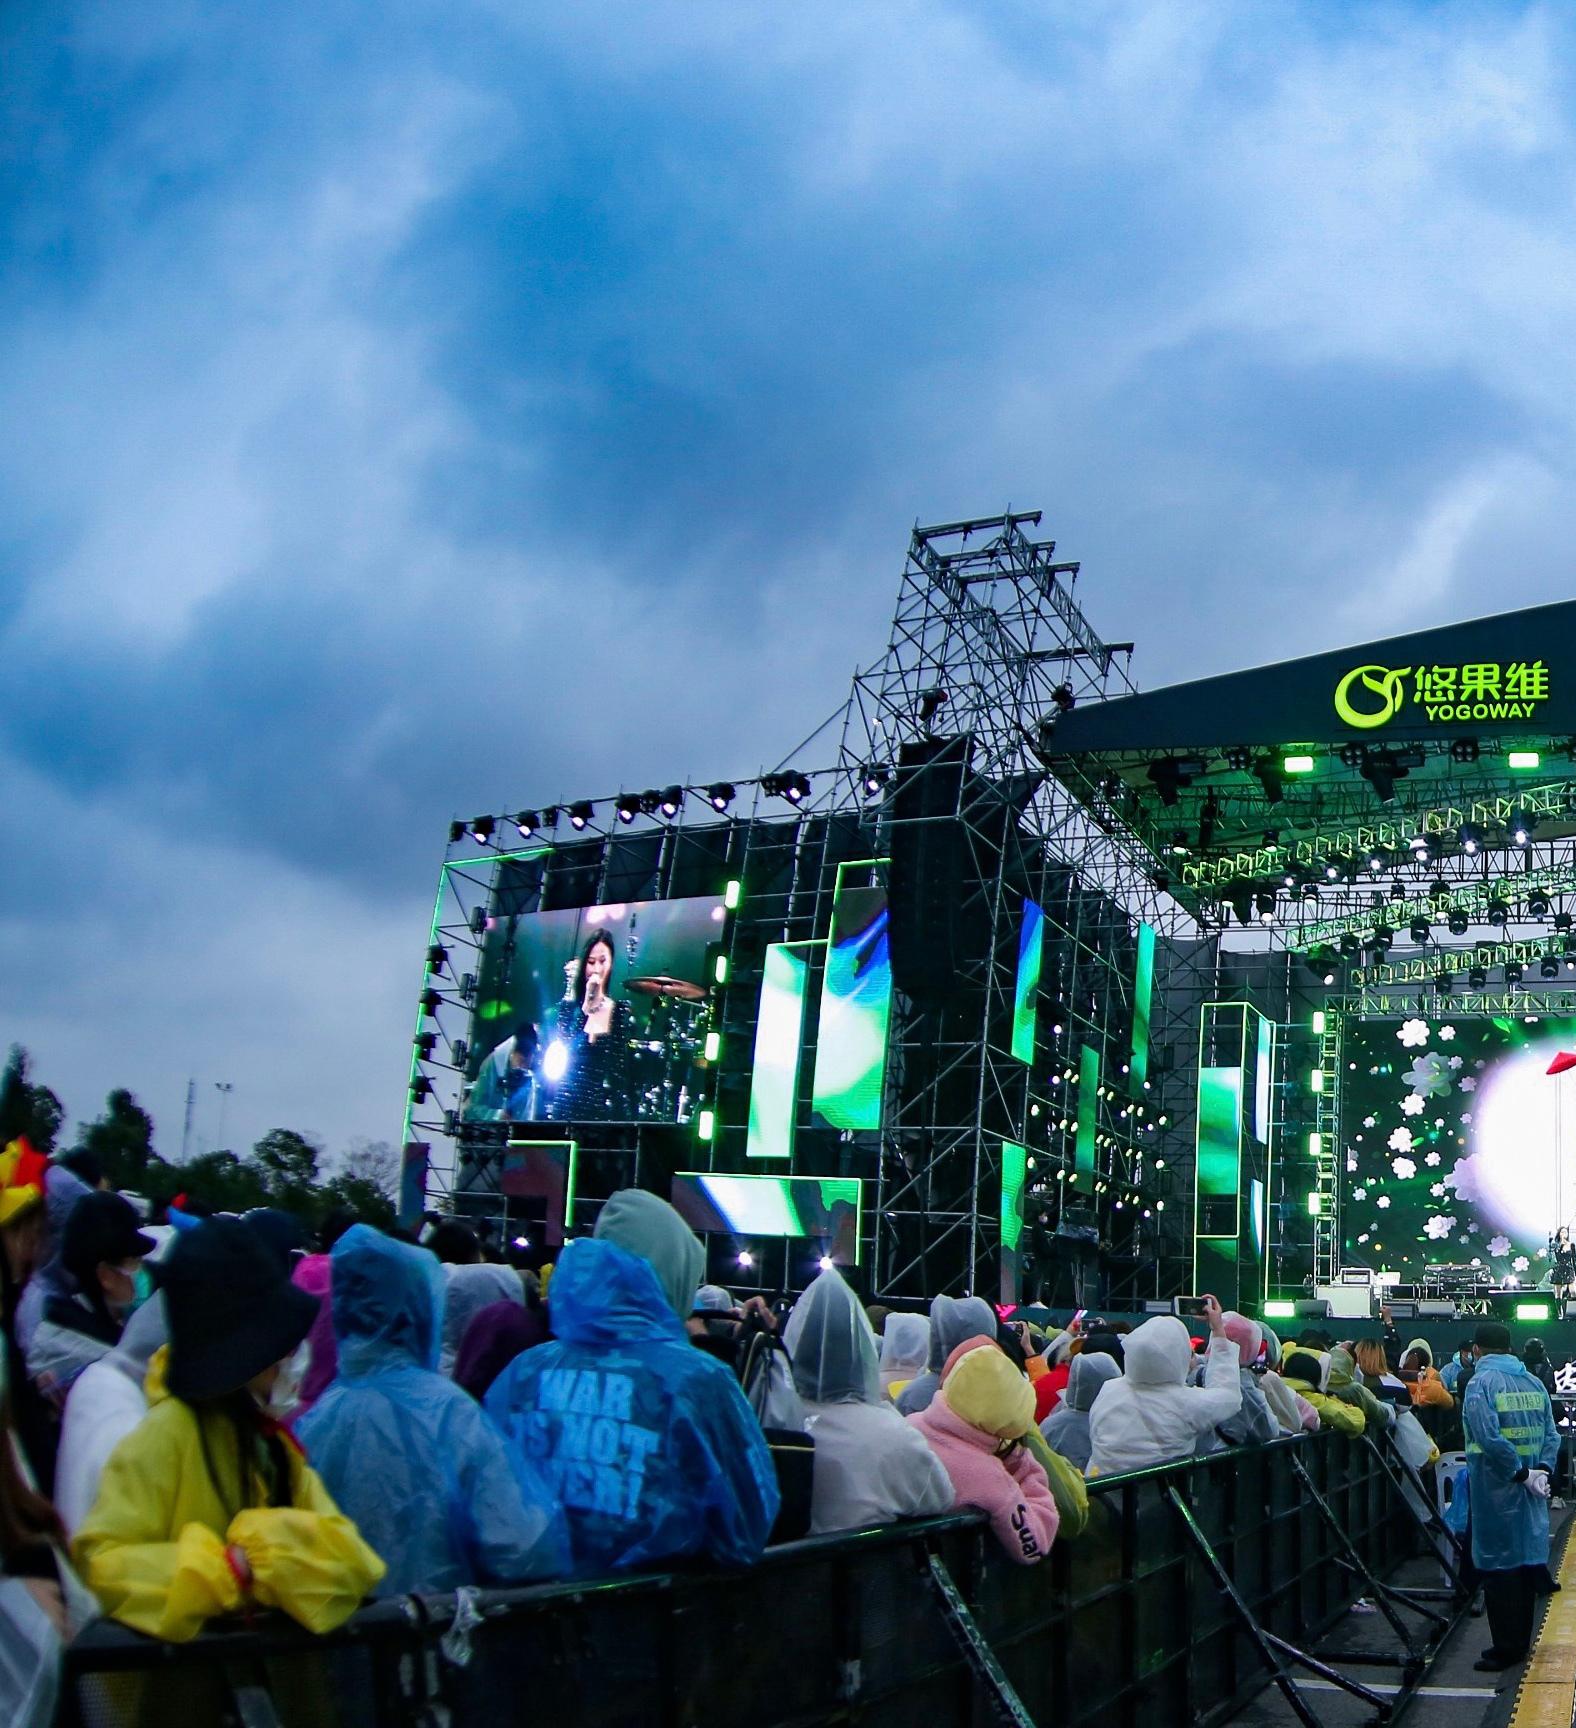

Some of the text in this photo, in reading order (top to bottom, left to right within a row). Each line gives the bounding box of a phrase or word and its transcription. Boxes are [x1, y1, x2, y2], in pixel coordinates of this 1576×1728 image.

[1413, 660, 1549, 703] 悠果维
[1425, 702, 1535, 721] YOGOWAY
[539, 1369, 633, 1421] WAR
[556, 1412, 660, 1474] NOT
